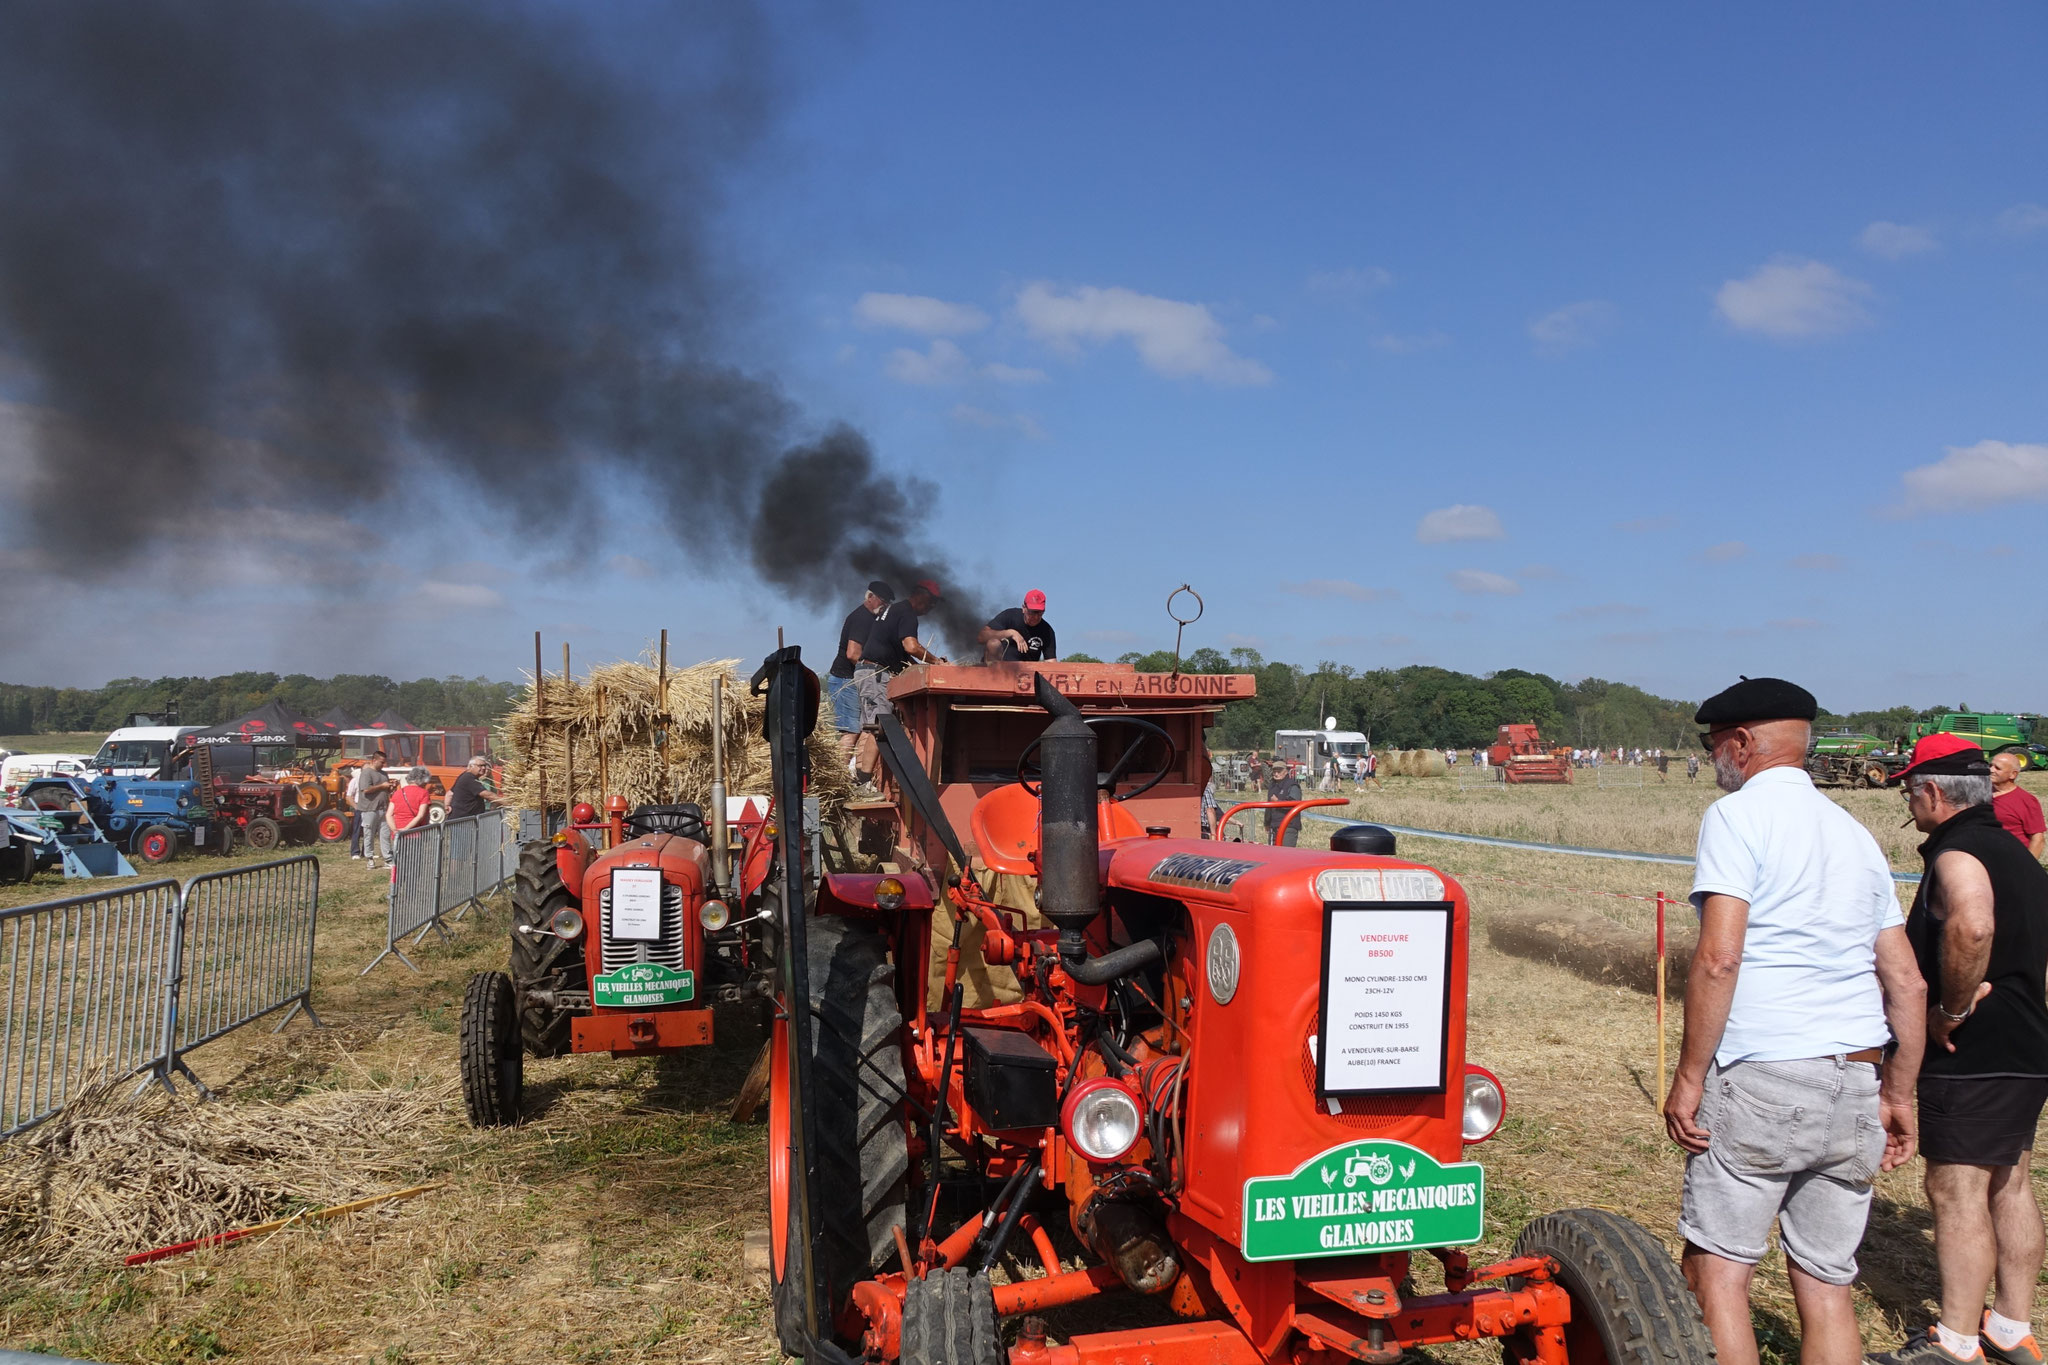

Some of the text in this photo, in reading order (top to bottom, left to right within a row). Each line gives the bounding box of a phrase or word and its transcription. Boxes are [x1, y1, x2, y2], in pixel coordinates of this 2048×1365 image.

[1017, 673, 1238, 694] GRY EN ARGONNE
[196, 736, 231, 744] 24MX
[1324, 875, 1437, 900] VENDEUVRE
[1360, 934, 1409, 942] VENDEUVRE
[1368, 949, 1394, 957] BB500
[1366, 975, 1413, 983] CYLINDRE-1350
[597, 978, 691, 992] LES VIEILLES MECANIQUES
[623, 993, 665, 1004] GLANOISES
[1347, 1046, 1420, 1054] VENDEUVRE-SUR-BARSE
[1254, 1182, 1476, 1222] LES VIEILLES MECANIQUES
[1319, 1218, 1414, 1248] GLANOISES
